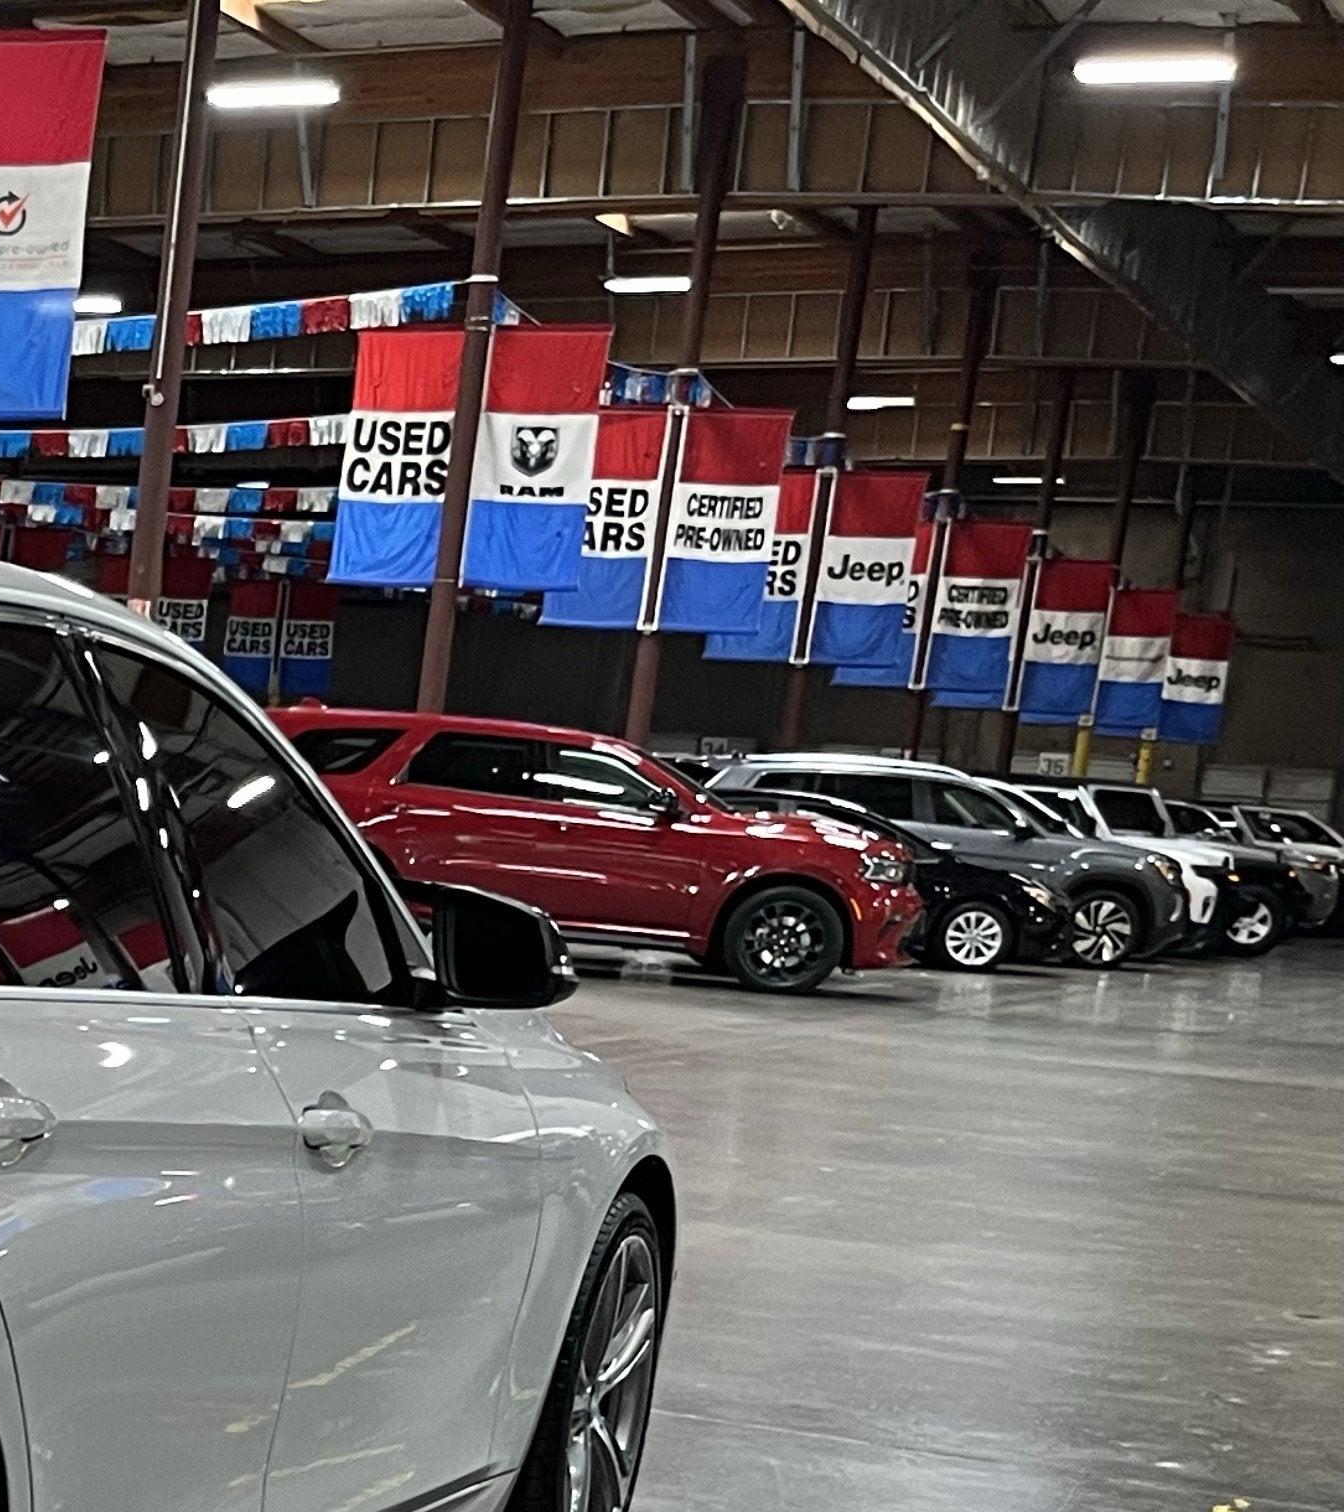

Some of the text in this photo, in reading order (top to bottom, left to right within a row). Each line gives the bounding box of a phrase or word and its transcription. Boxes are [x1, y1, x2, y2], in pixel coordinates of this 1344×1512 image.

[353, 418, 451, 456] USED
[346, 457, 449, 496] CARS
[500, 484, 564, 497] RAM
[589, 487, 649, 518] SED
[687, 493, 764, 519] CERTIFIED
[583, 522, 646, 551] ARS
[674, 524, 765, 551] PRE-OWNED
[827, 554, 904, 587] Jeep
[158, 601, 204, 619] USED
[228, 621, 272, 638] USED
[286, 623, 330, 639] USED
[1032, 623, 1096, 650] Jeep
[226, 638, 271, 654] CARS
[284, 640, 329, 656] CARS
[1166, 669, 1221, 693] Jeep
